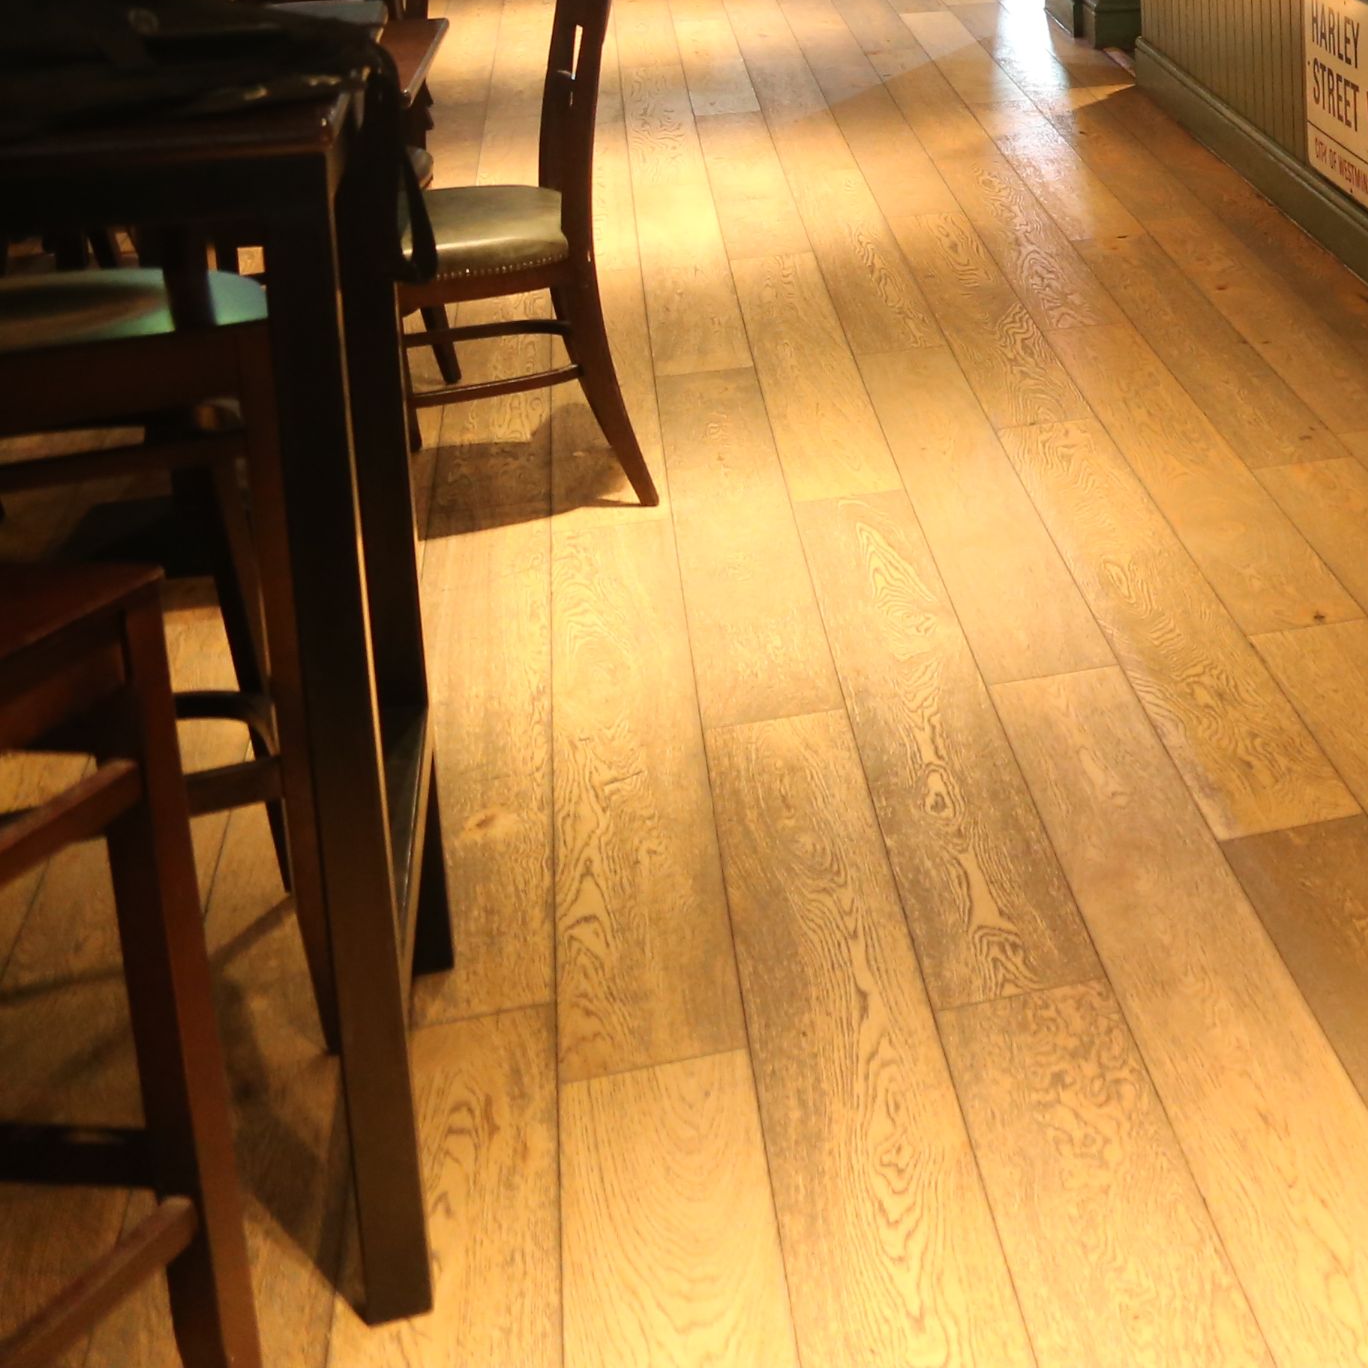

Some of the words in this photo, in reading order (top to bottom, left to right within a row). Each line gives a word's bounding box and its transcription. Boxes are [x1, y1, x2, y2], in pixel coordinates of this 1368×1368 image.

[1312, 56, 1360, 133] STREET
[1314, 136, 1327, 167] CITY
[1328, 147, 1338, 171] OF
